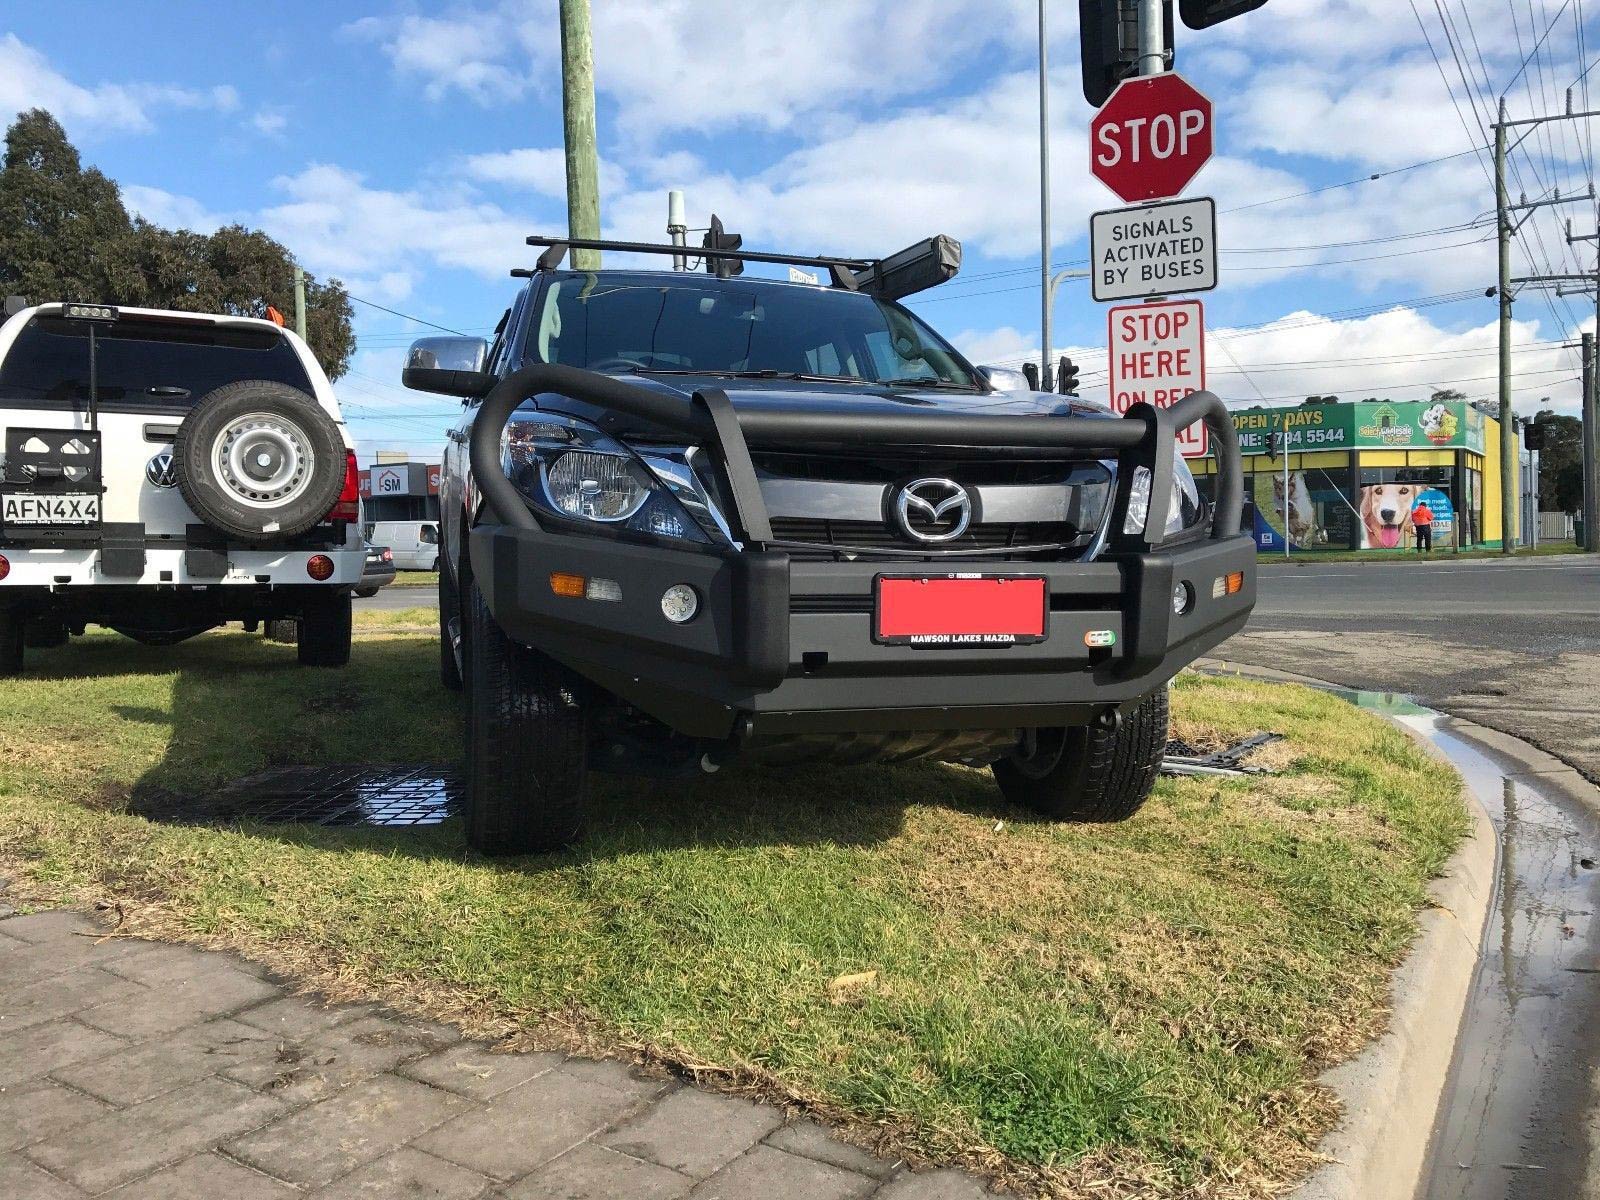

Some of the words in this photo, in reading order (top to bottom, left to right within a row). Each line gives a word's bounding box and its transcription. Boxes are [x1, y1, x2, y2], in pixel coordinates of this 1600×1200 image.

[1098, 109, 1205, 167] STOP
[1112, 216, 1193, 241] SIGNALS
[1103, 237, 1204, 264] ACTIVATED
[1104, 267, 1129, 286] BY
[1141, 259, 1204, 281] BUSES
[1121, 311, 1189, 342] STOP
[1121, 349, 1191, 379] HERE
[1231, 414, 1267, 430] OPEN
[1272, 414, 1280, 427] 7
[1286, 411, 1323, 426] DAYS
[1306, 428, 1344, 443] 5544
[5, 499, 98, 518] AFN4X4
[910, 635, 950, 643] MAWSON
[952, 634, 982, 643] LAKES
[984, 634, 1016, 642] MAZDA
